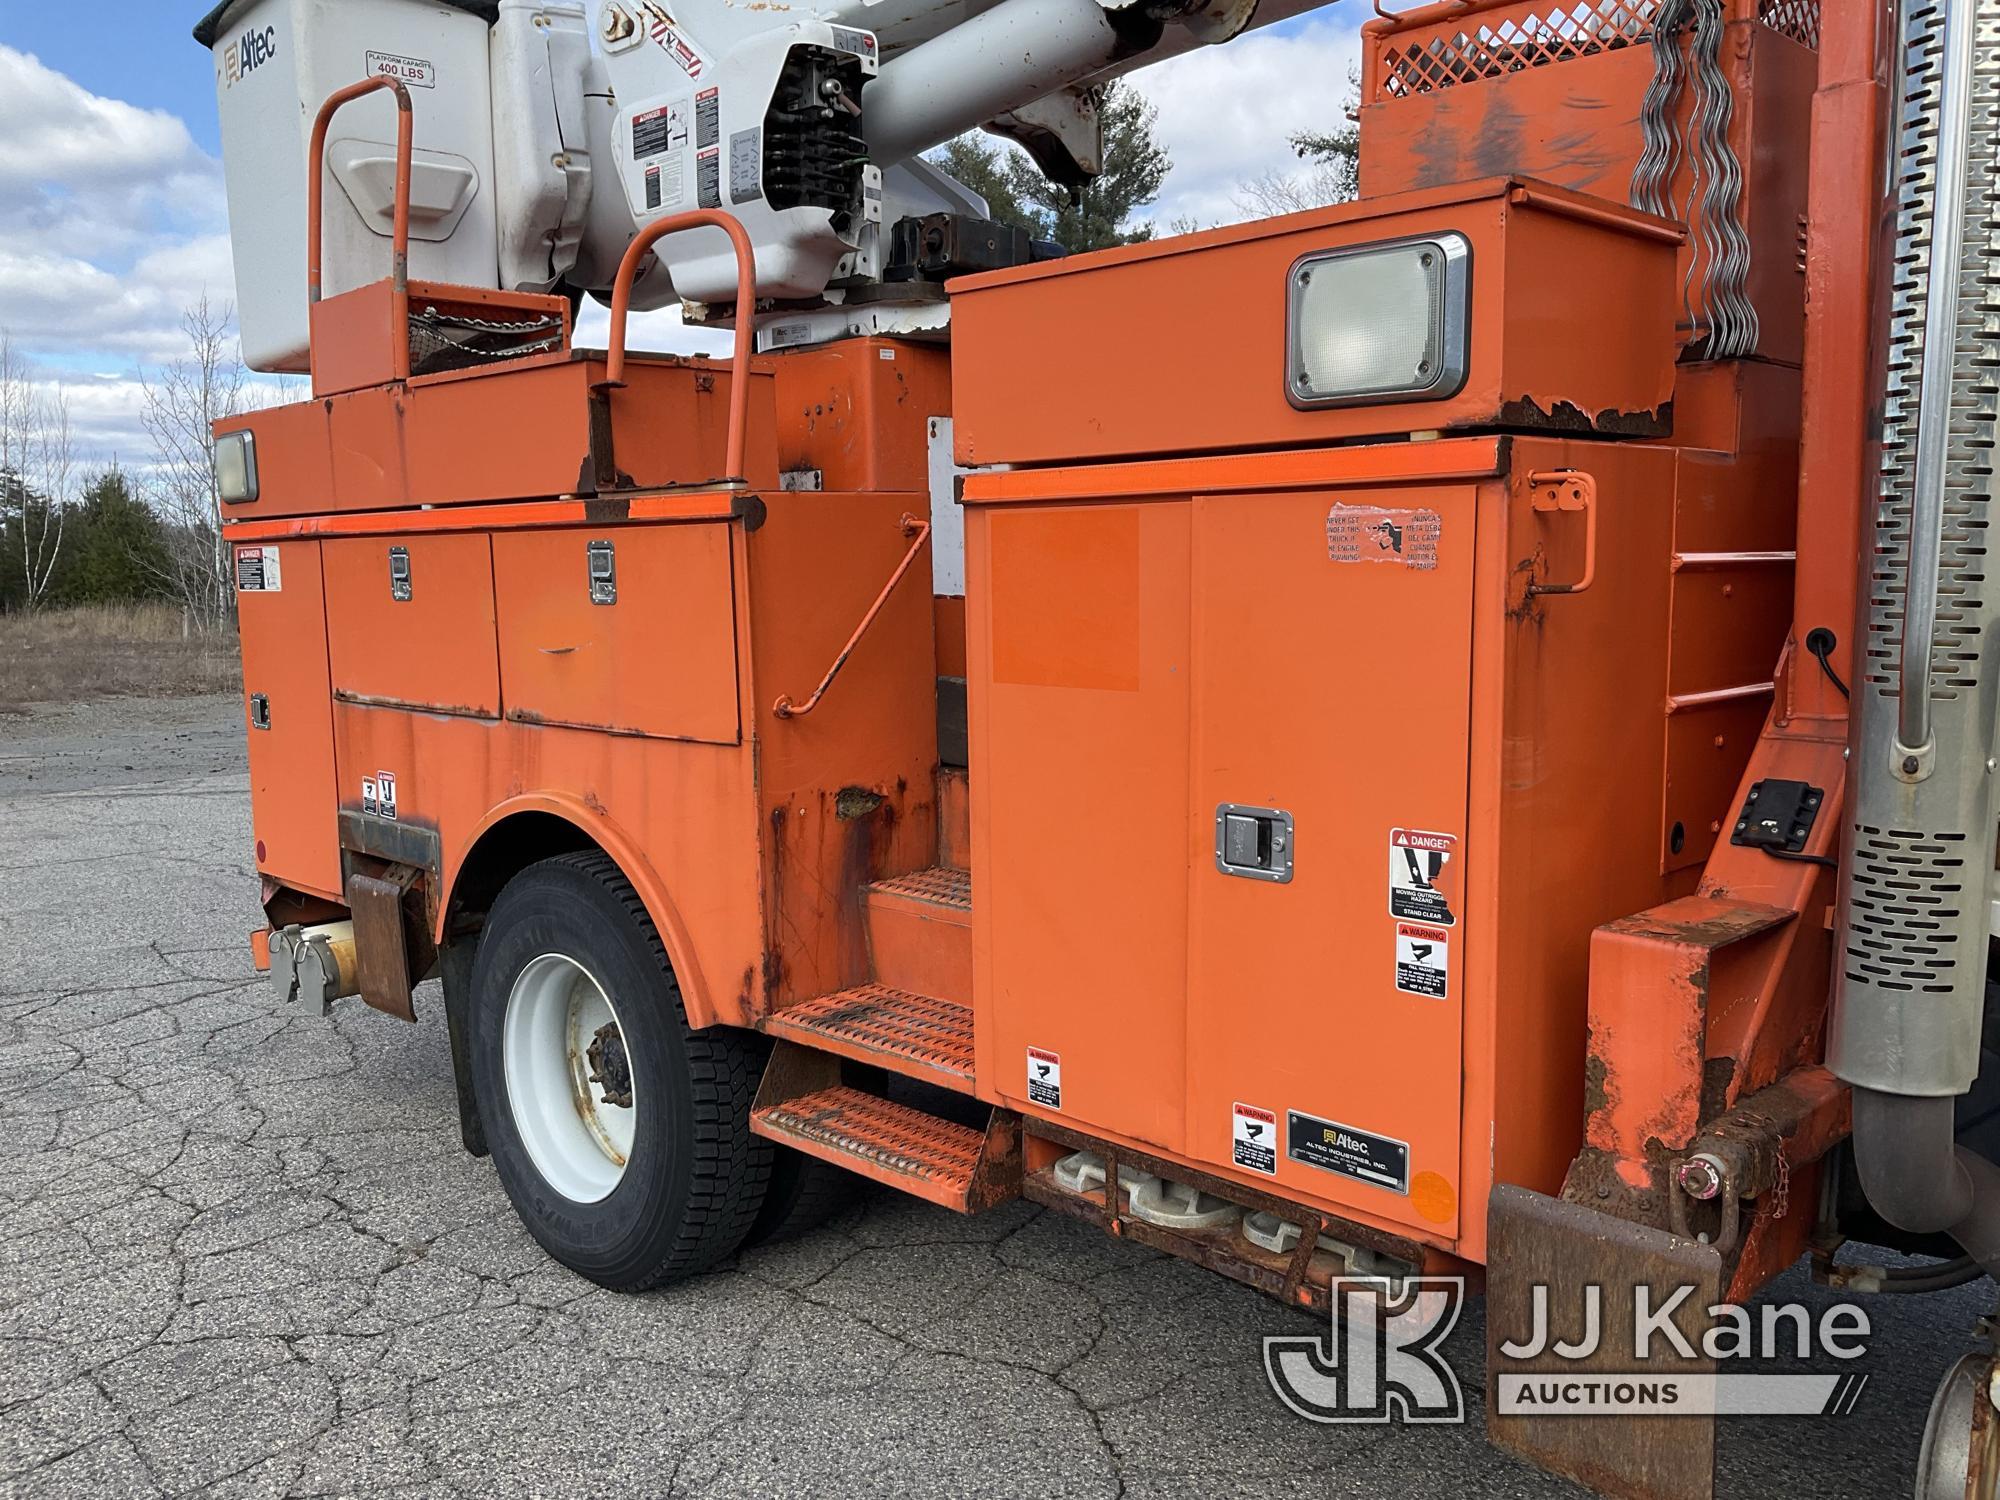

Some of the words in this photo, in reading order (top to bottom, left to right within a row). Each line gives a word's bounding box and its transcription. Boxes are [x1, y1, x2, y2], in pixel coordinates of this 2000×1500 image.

[241, 25, 276, 78] Altec
[368, 53, 401, 64] PLATFORM
[402, 60, 431, 69] CAPACITY
[378, 63, 398, 75] 400
[401, 66, 424, 80] LBS
[1395, 889, 1417, 897] MOVING
[1410, 896, 1433, 904] HAZARD
[1403, 908, 1422, 916] STAND
[1422, 911, 1442, 919] CLEAR
[1410, 927, 1444, 941] WARNING
[1244, 1107, 1273, 1122] WARNING
[1337, 1133, 1368, 1154] Altec
[1305, 1141, 1327, 1152] ALTEC
[1328, 1148, 1372, 1167] INDUSTRIES,
[1373, 1161, 1388, 1170] INC.
